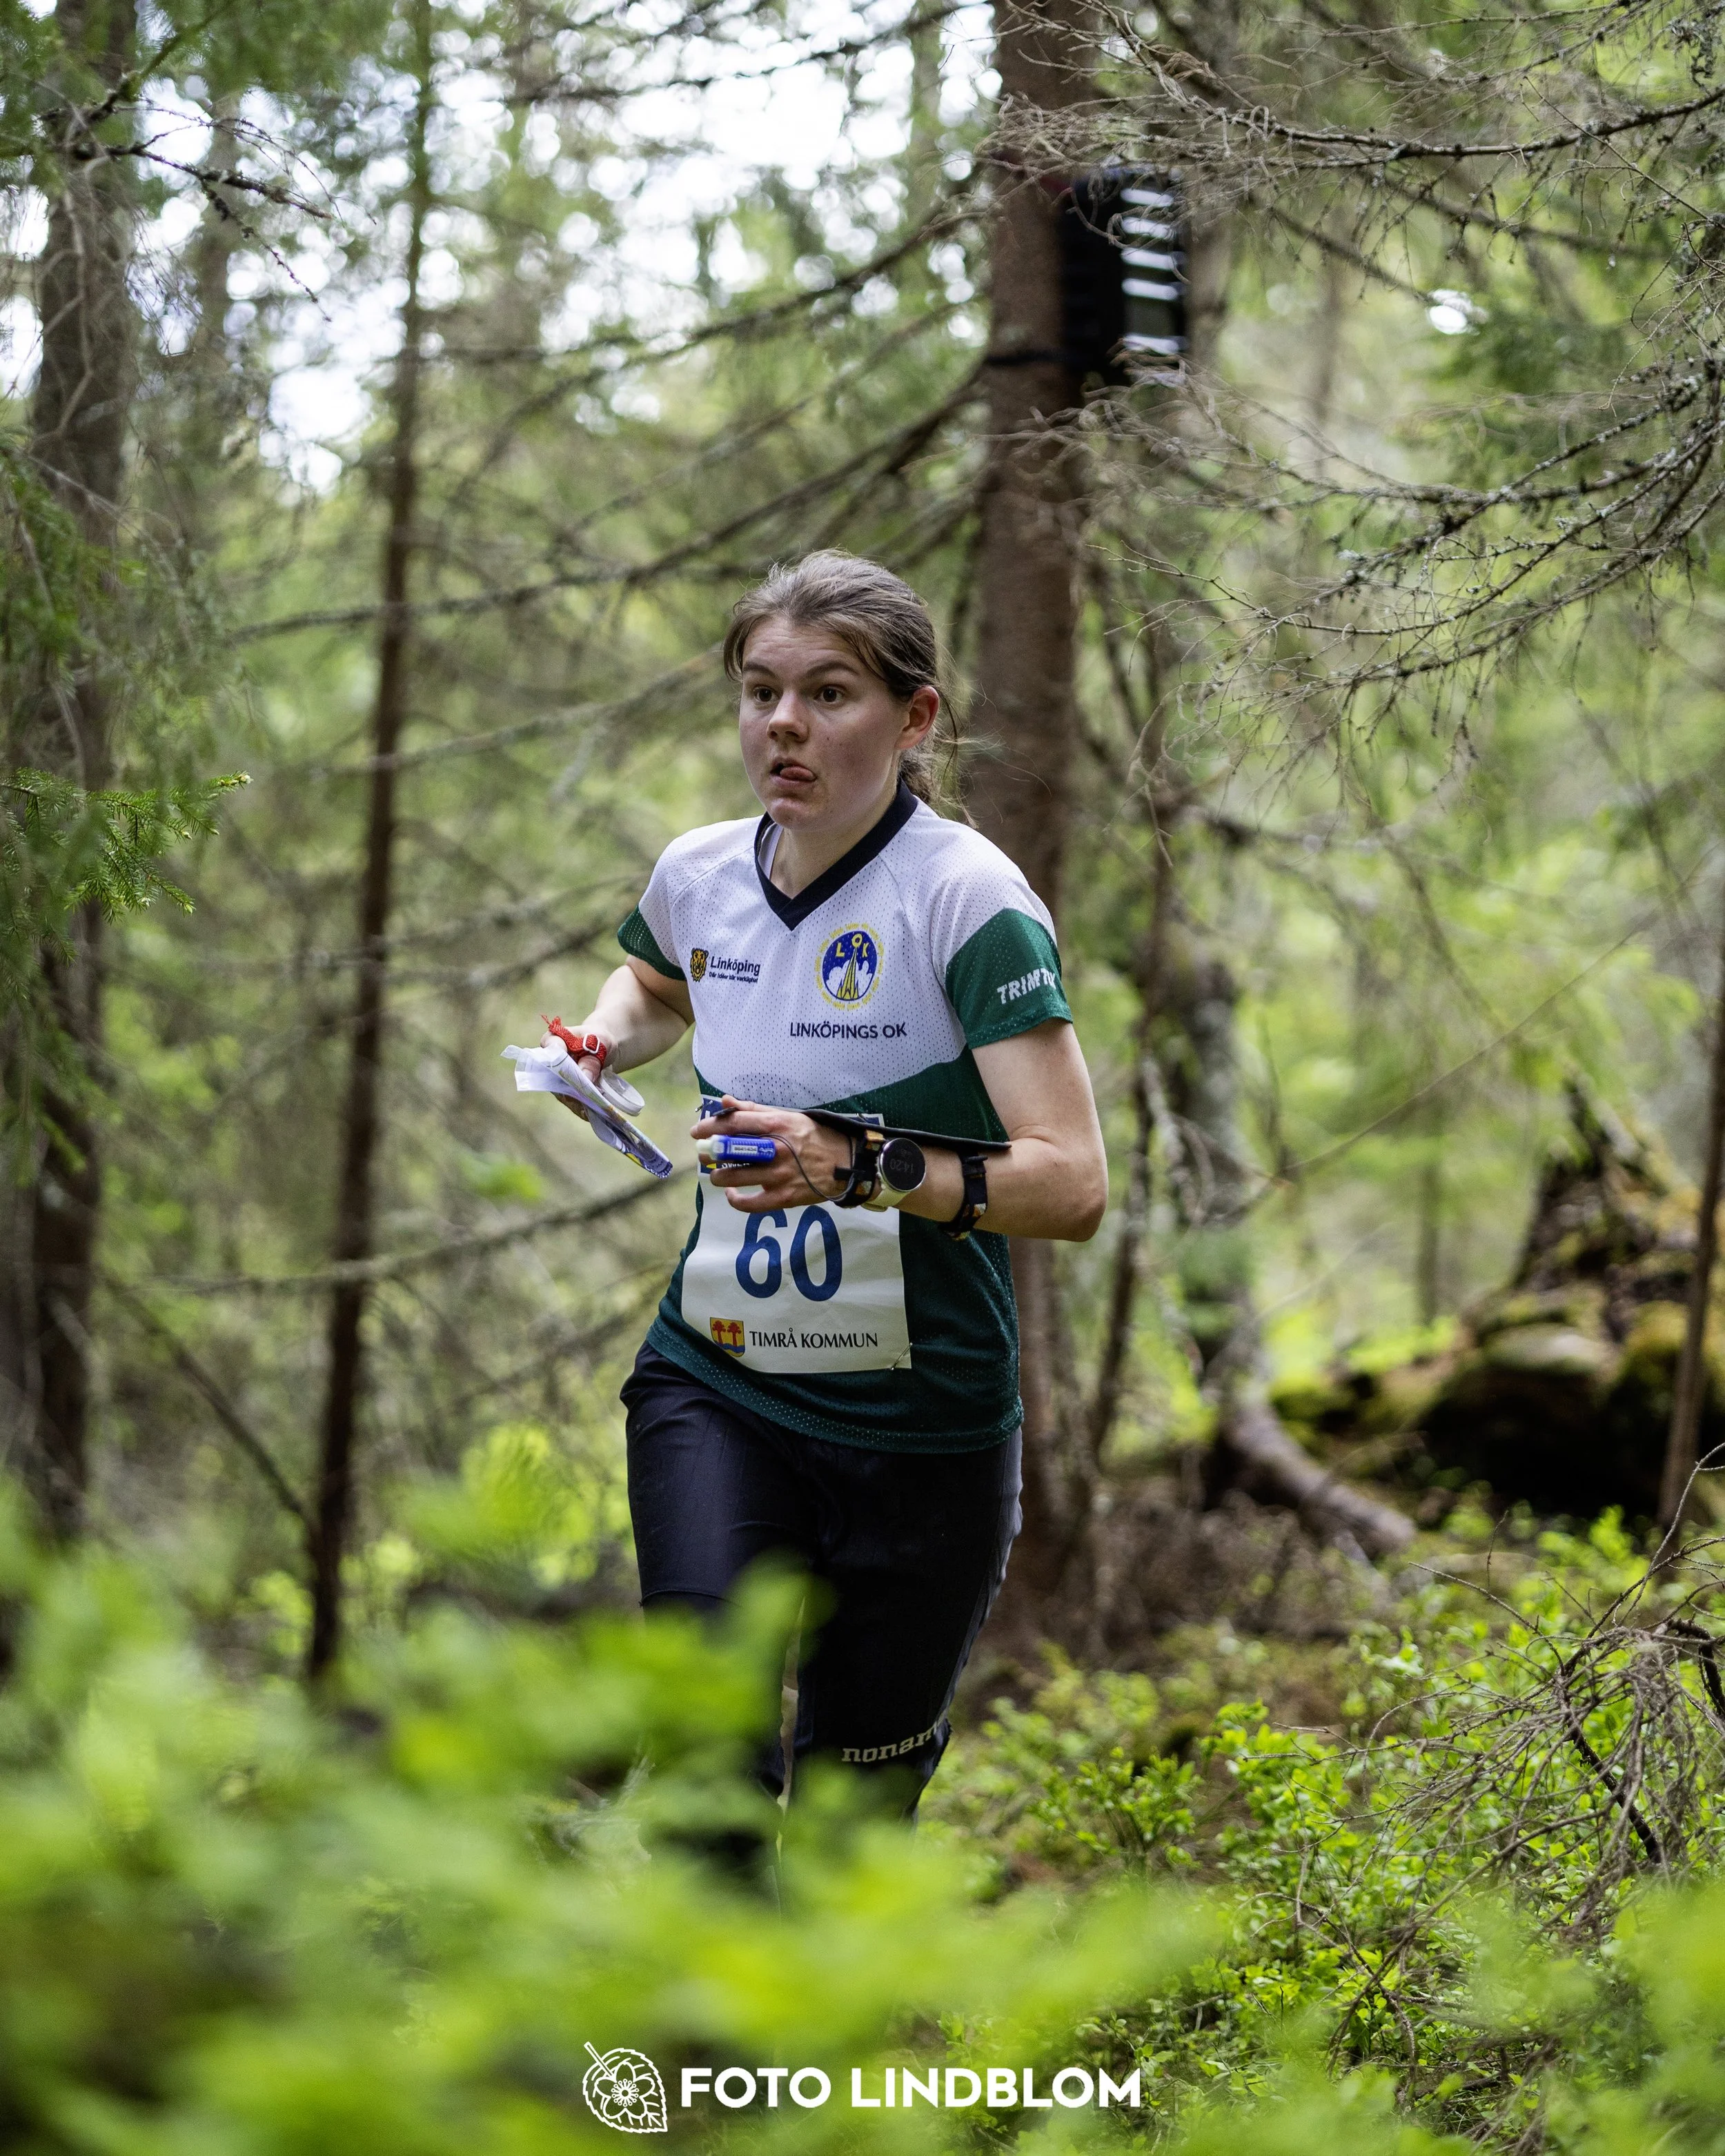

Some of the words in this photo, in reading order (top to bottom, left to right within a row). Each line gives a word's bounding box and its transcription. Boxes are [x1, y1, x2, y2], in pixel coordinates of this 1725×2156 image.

[710, 956, 760, 976] Linköping
[790, 1020, 878, 1040] LINKÖPINGS
[883, 1022, 908, 1038] OK
[736, 1205, 842, 1302] 60
[749, 1327, 797, 1347] TIMRÅ
[801, 1333, 878, 1348] KOMMUN
